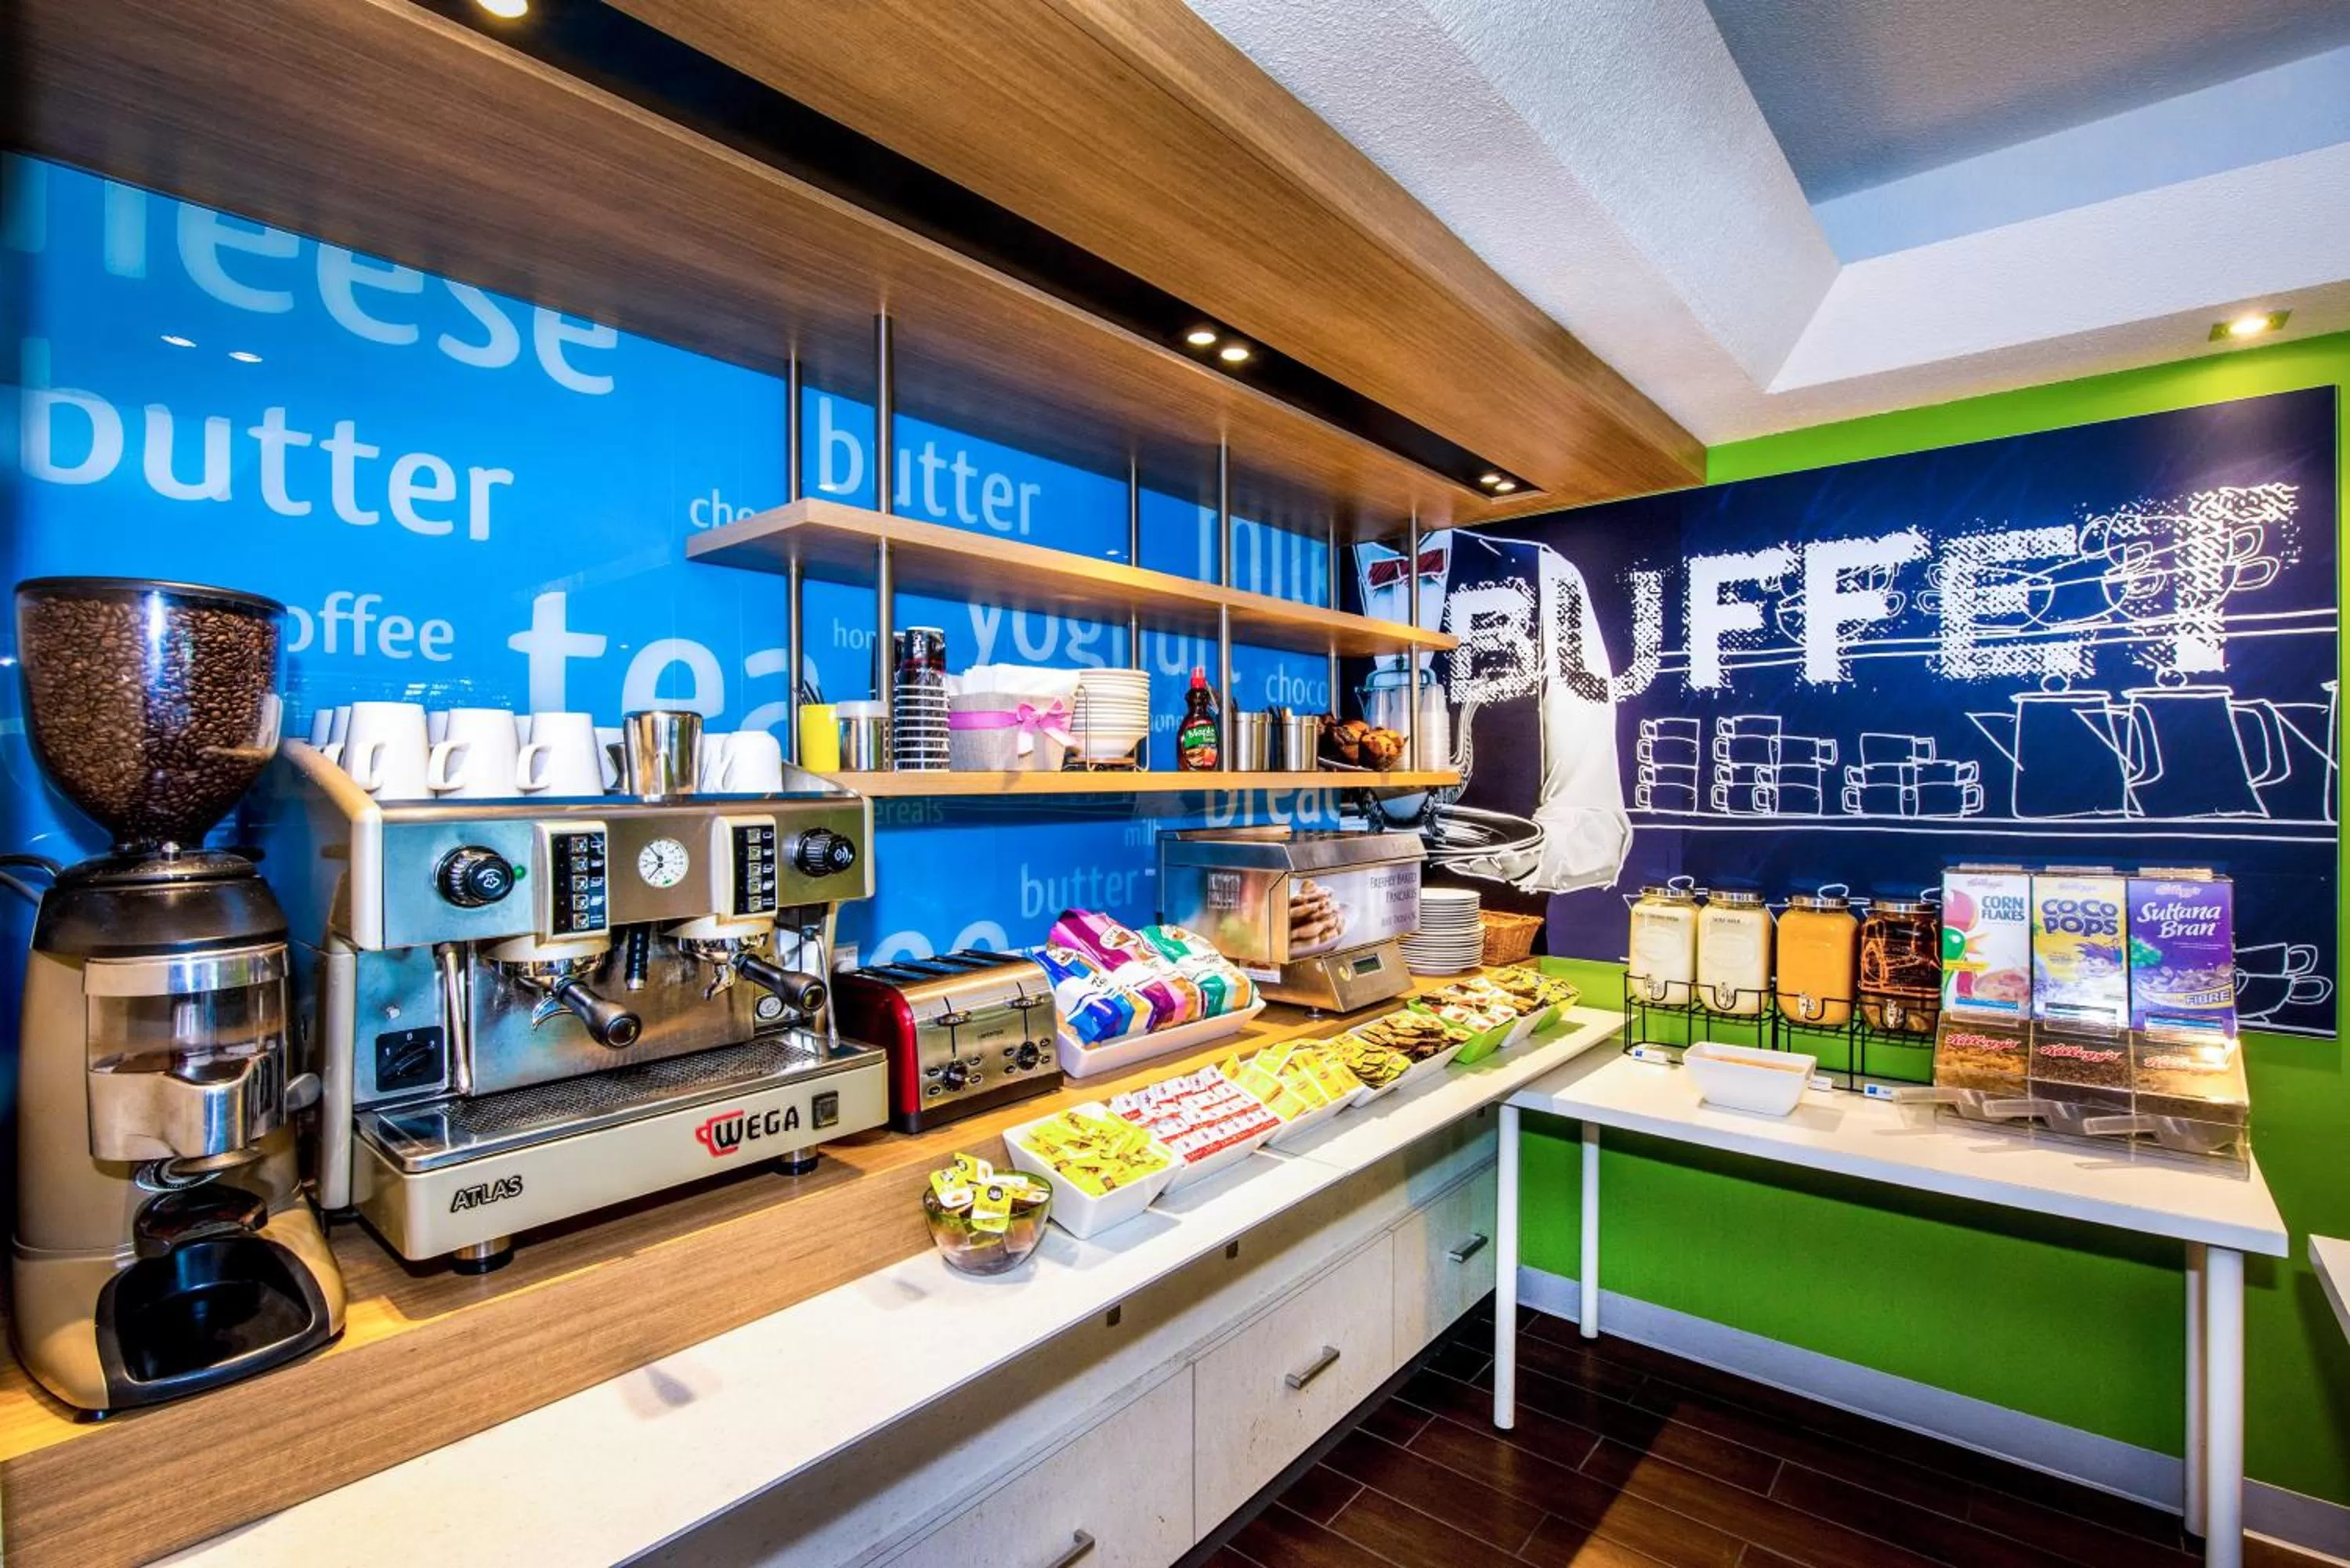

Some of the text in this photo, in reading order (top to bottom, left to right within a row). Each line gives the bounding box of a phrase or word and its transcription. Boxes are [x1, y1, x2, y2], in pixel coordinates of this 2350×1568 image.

[20, 337, 514, 540] butter
[819, 396, 1041, 536] butter
[1444, 482, 2300, 705] BUFFET
[287, 591, 454, 662] offee
[967, 600, 1241, 683] yogu
[1265, 663, 1329, 707] choco
[874, 797, 943, 826] ereals
[1021, 862, 1137, 919] butter
[1981, 895, 2024, 909] CORN
[2041, 898, 2118, 917] COCO
[1981, 909, 2025, 922] FLAKES
[2043, 915, 2119, 937] POPS
[2136, 901, 2222, 923] Sultana
[2157, 920, 2217, 939] Bran
[2185, 988, 2231, 1006] FIBRE
[713, 1105, 800, 1150] WEGA
[450, 1176, 523, 1212] ATLAS
